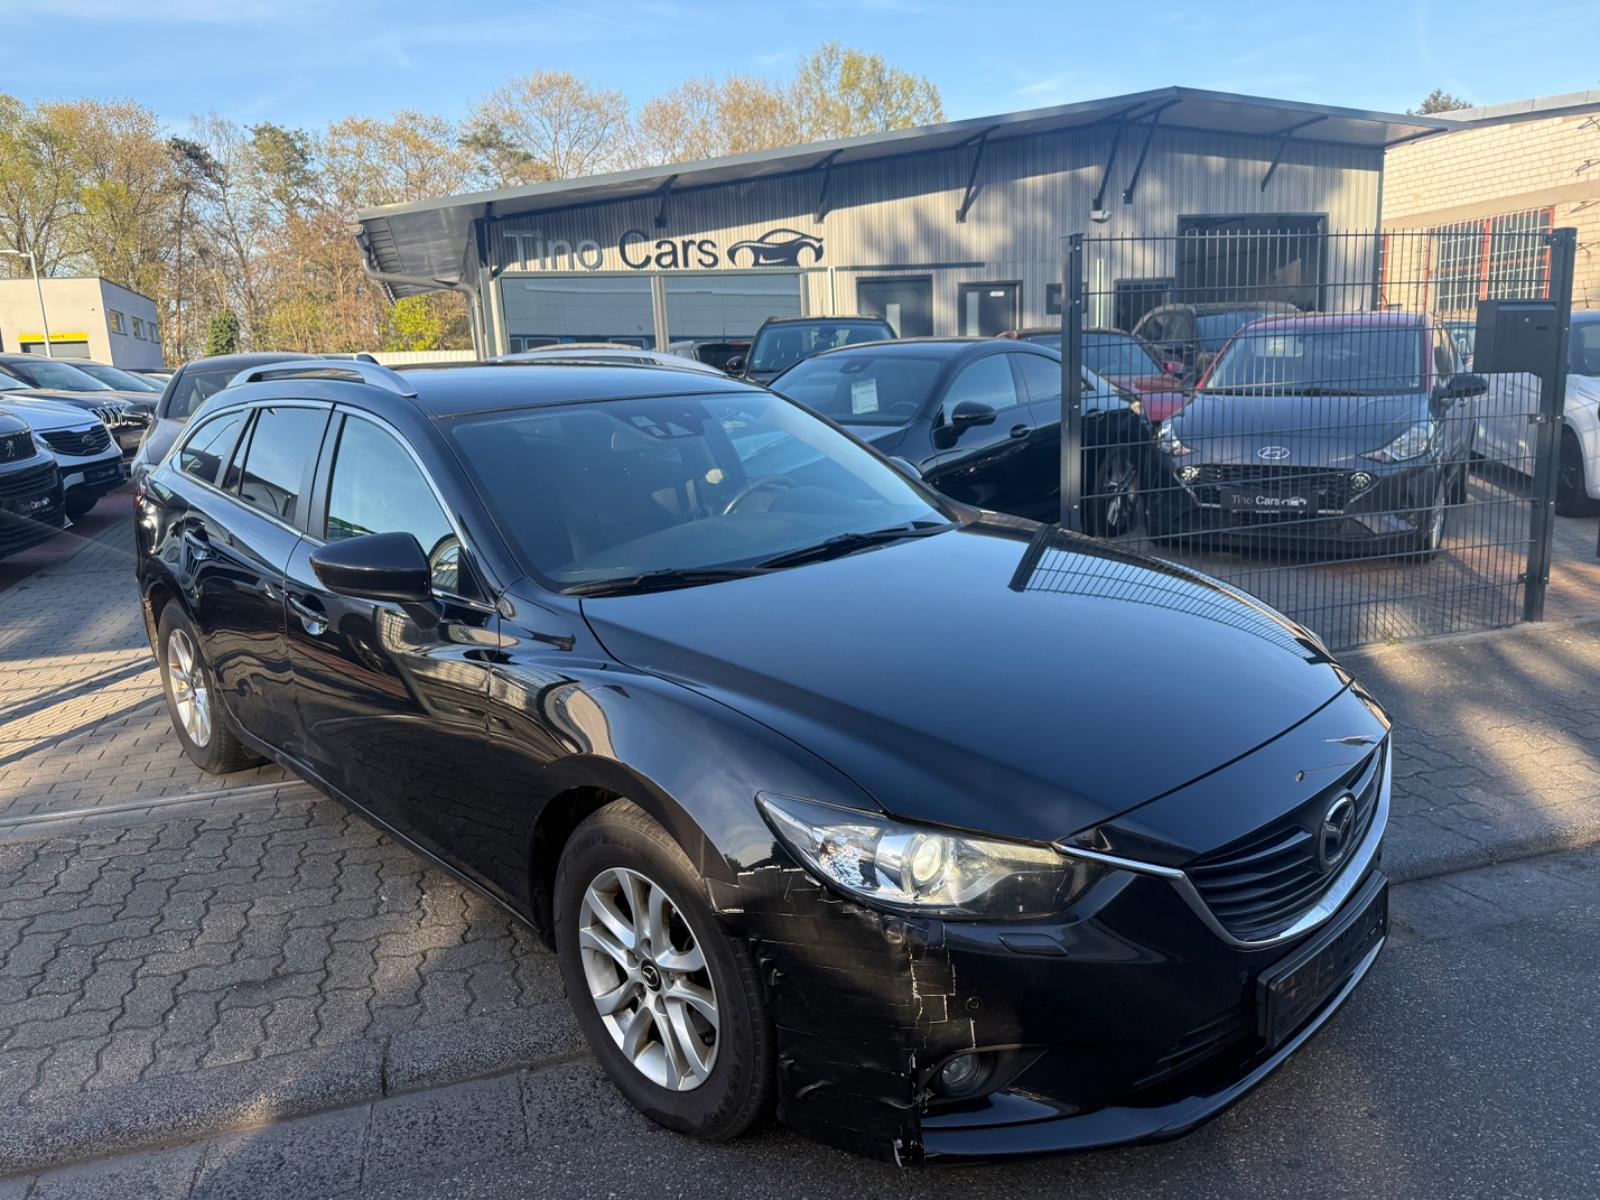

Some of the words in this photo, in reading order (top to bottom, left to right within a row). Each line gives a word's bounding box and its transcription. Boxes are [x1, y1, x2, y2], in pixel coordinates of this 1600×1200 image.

[503, 230, 604, 270] Tino
[618, 229, 719, 269] Cars
[1255, 494, 1280, 506] Cars
